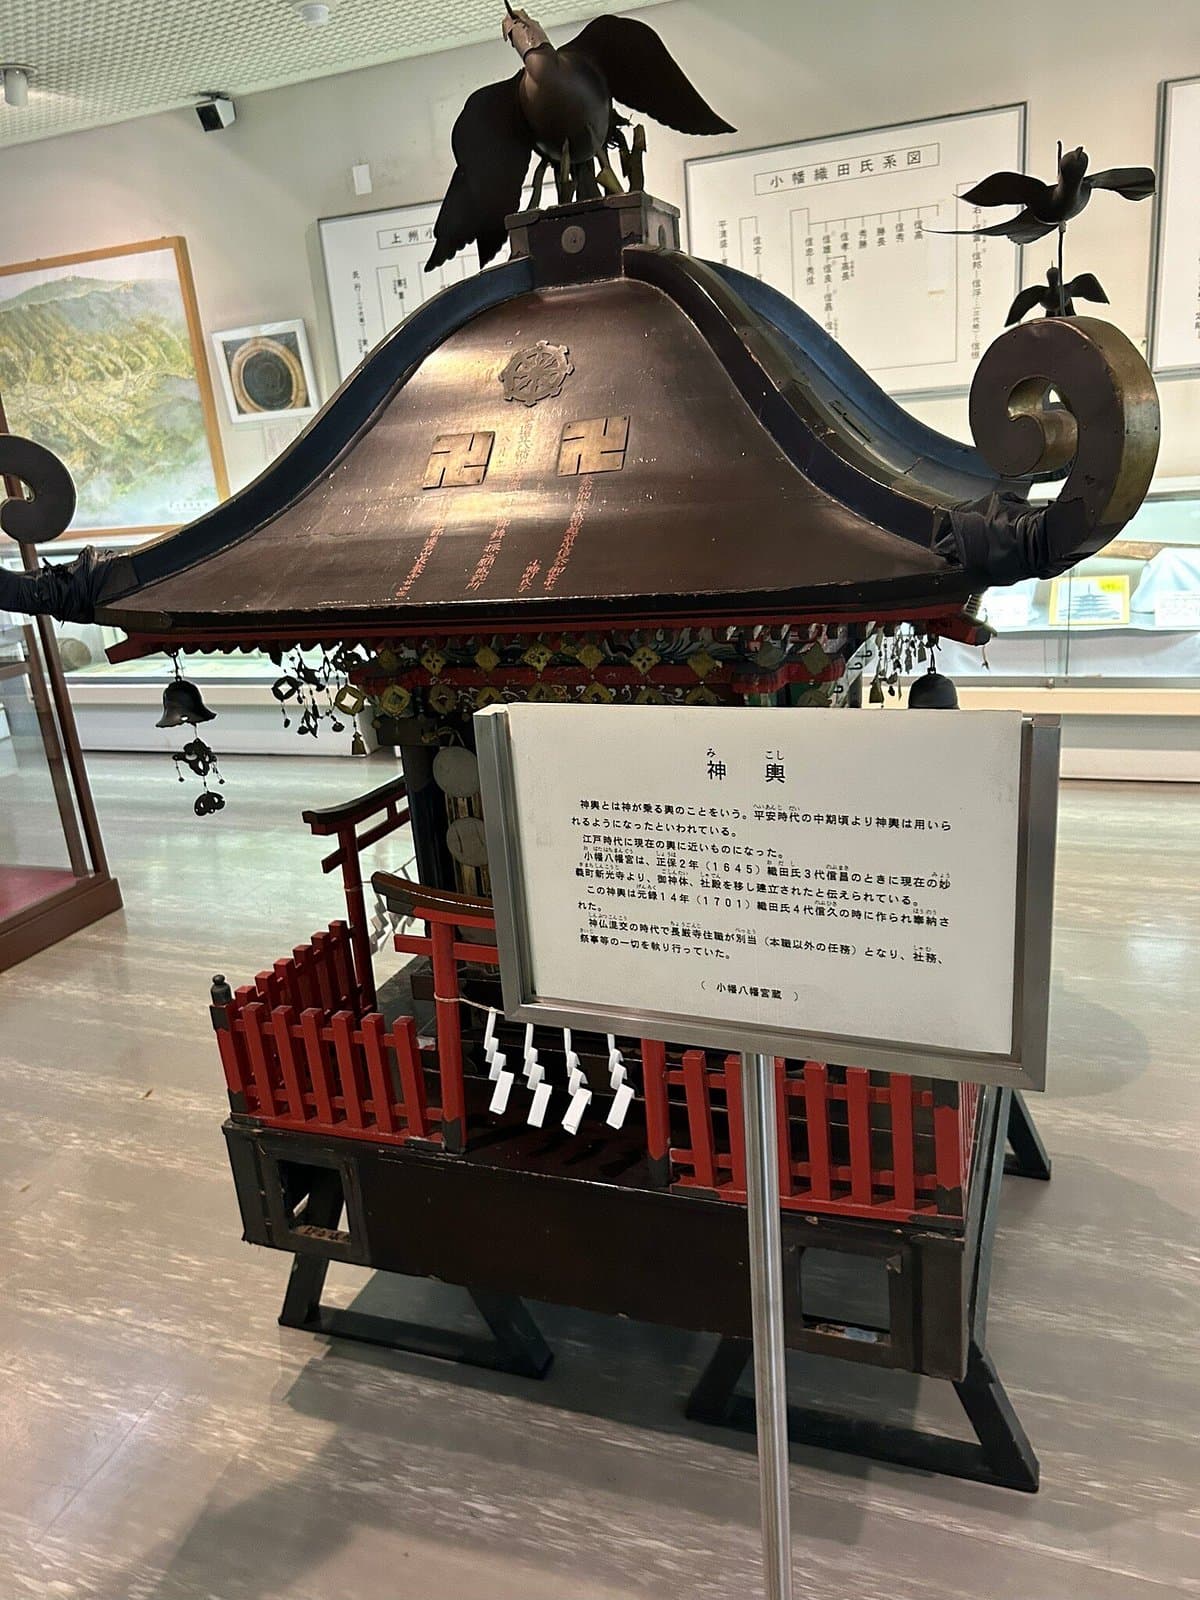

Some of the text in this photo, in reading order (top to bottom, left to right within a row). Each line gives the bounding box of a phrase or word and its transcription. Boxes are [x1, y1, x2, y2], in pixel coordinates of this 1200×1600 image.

[770, 150, 922, 188] 小幡織田氏系図
[706, 748, 785, 761] み こし
[571, 816, 737, 838] れるようになったといわれている。
[582, 833, 784, 859] 江戸時代に現在の輿に近いものになった。
[577, 901, 602, 912] れた。
